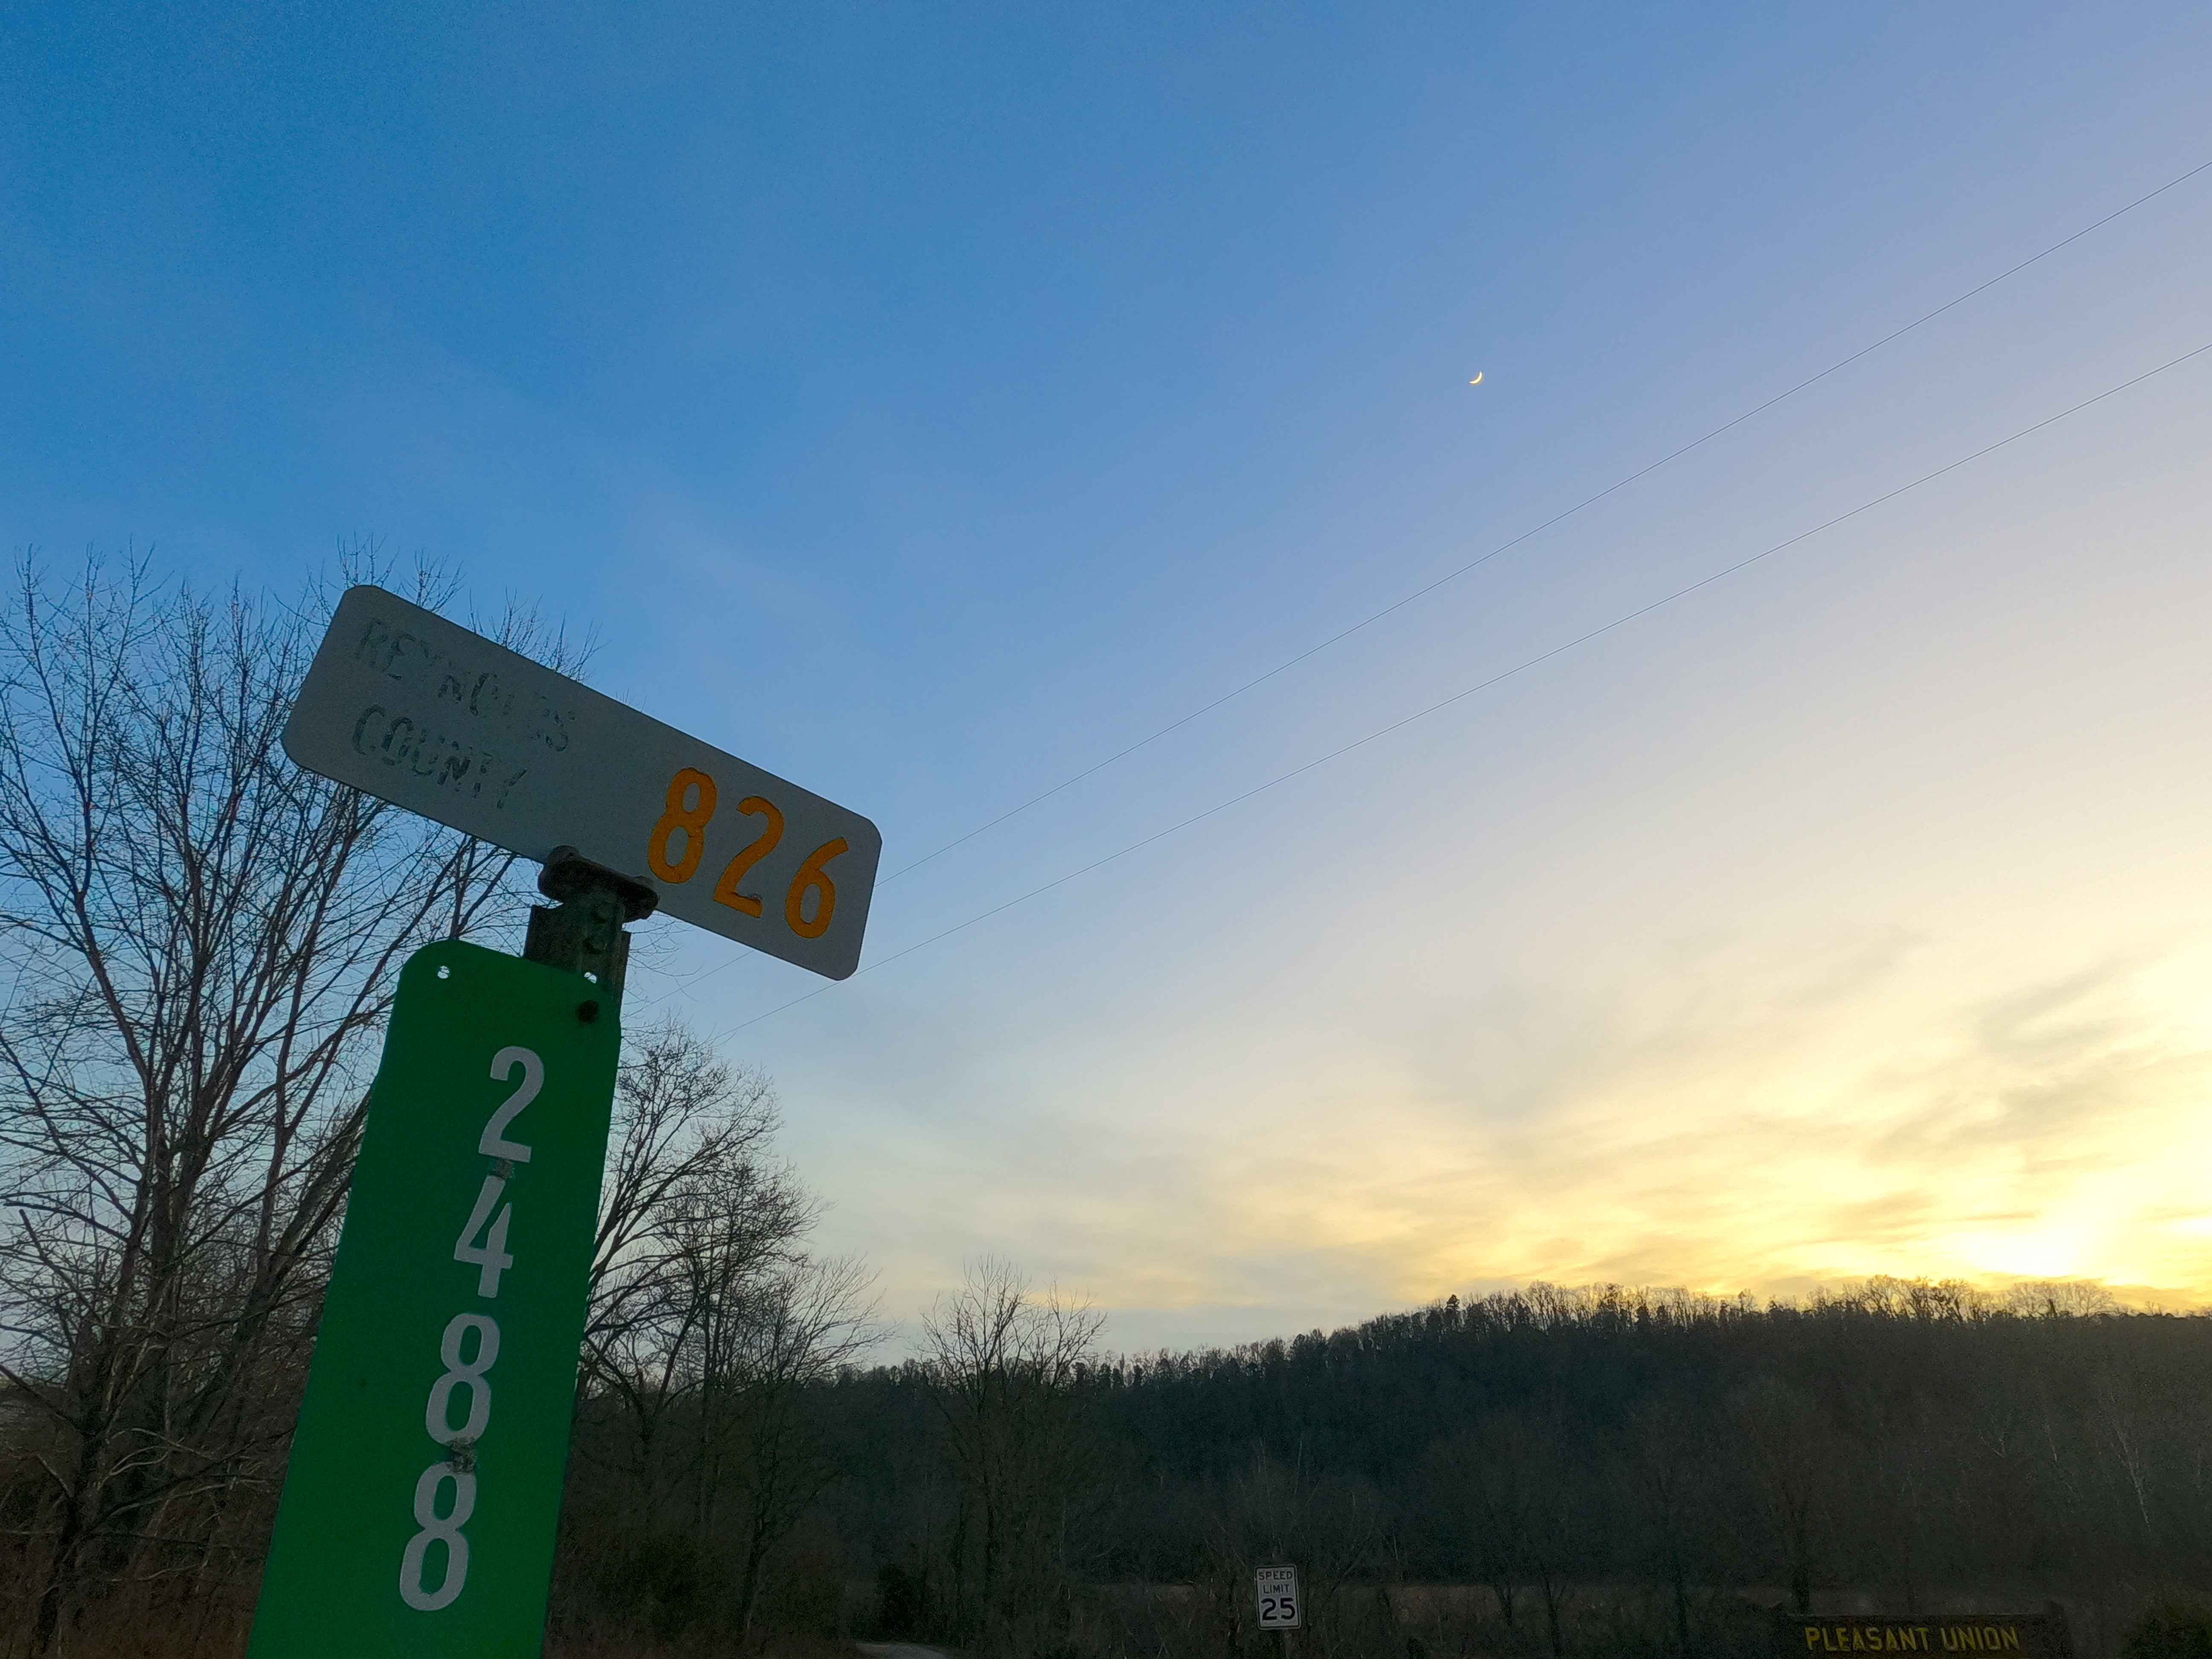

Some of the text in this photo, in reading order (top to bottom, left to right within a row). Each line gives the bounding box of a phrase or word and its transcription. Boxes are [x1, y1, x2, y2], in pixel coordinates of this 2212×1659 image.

[647, 767, 849, 939] 826
[399, 1045, 544, 1611] 2488
[1259, 1571, 1293, 1580] SPEED
[1263, 1584, 1289, 1594] LIMIT
[1261, 1597, 1295, 1620] 25
[1804, 1626, 2020, 1652] PLEASANT UNION
